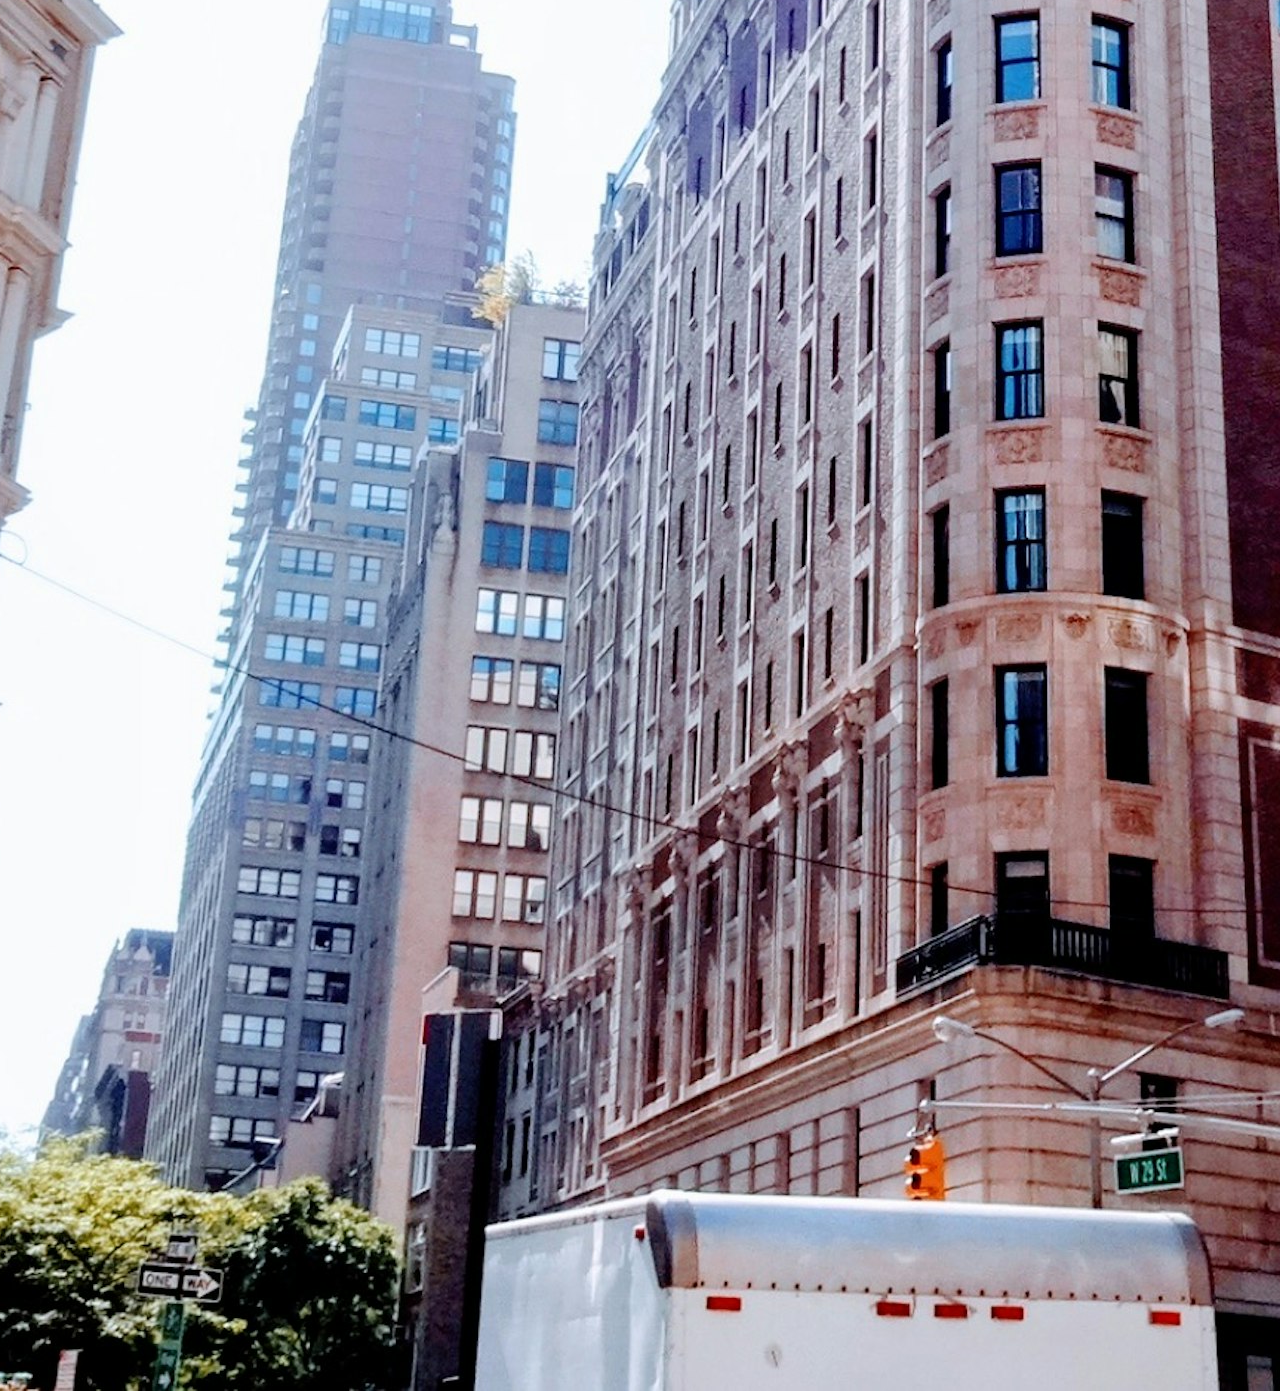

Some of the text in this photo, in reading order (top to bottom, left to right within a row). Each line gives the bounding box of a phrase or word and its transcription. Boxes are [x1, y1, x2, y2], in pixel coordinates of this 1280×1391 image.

[1130, 1159, 1168, 1184] W 29 St
[146, 1274, 212, 1290] ONE WAY
